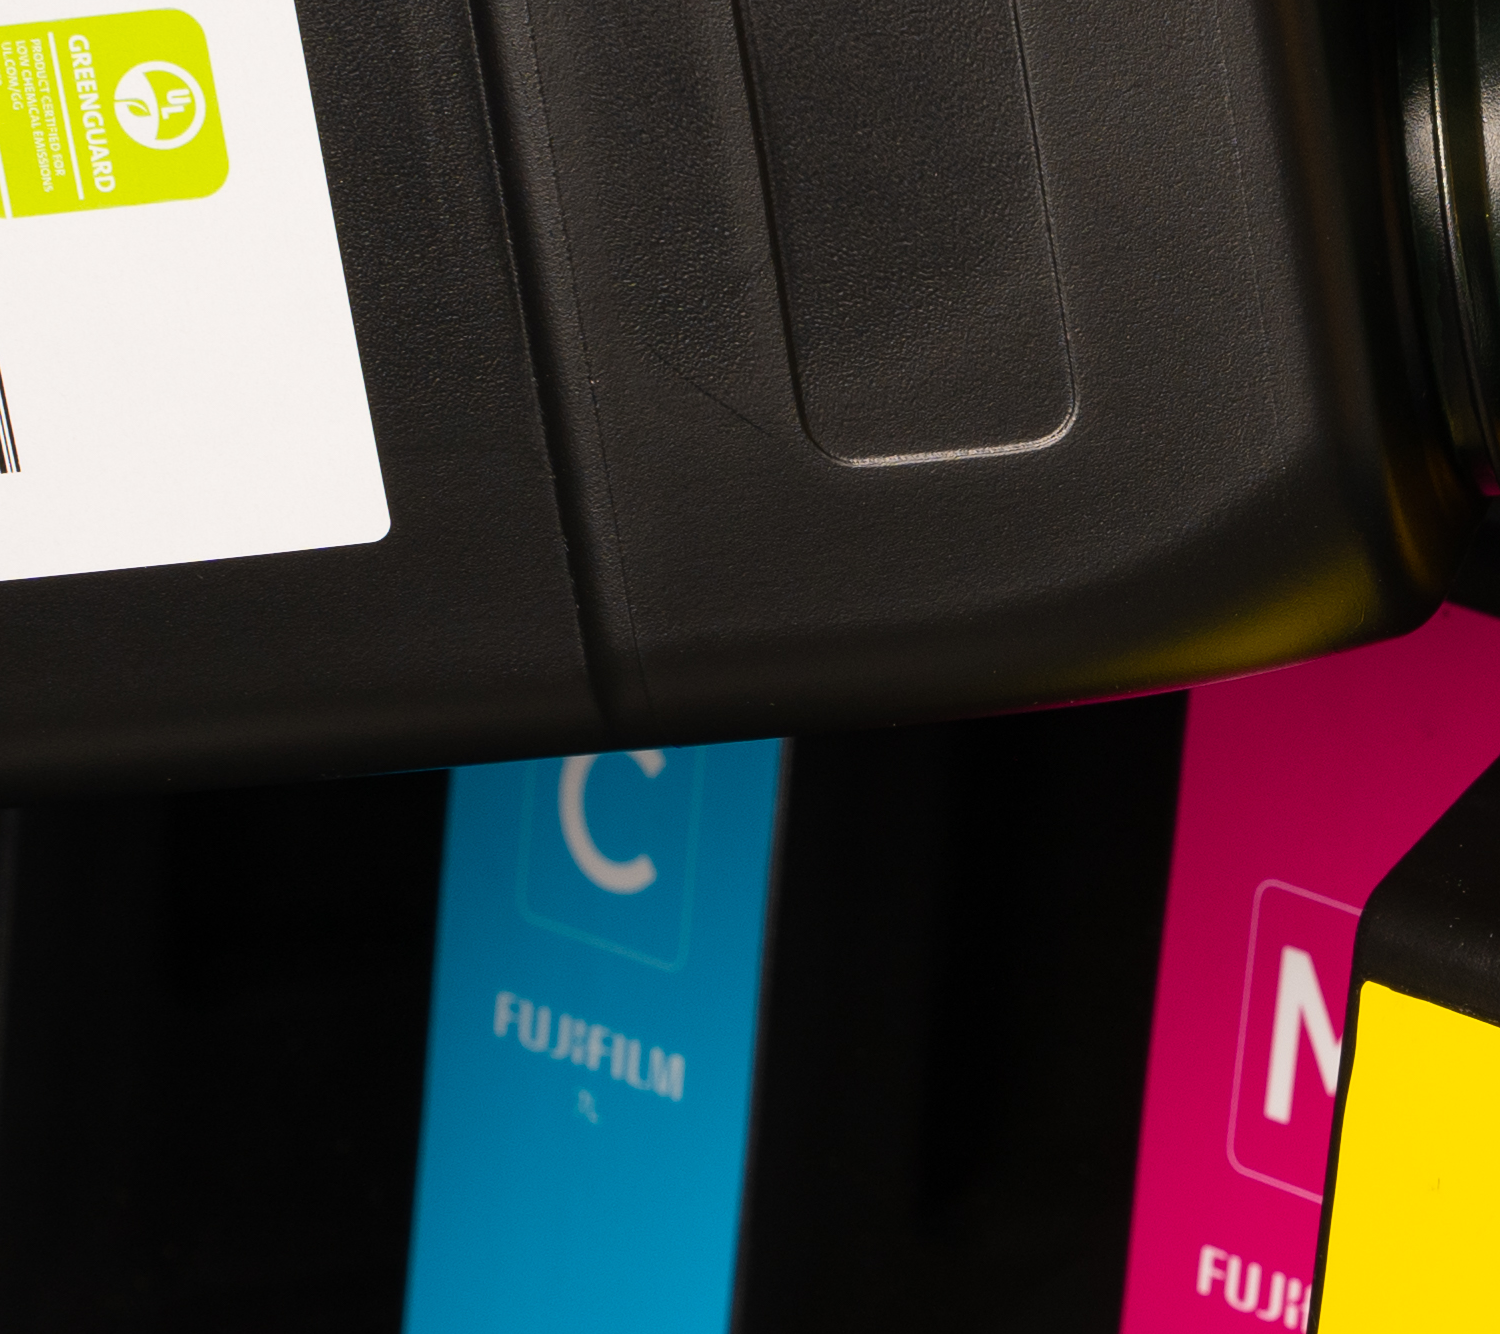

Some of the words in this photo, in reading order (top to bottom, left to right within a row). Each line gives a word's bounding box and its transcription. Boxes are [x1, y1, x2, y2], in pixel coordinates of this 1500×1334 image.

[15, 39, 30, 67] LOW
[21, 69, 41, 129] CHEMICAL
[30, 38, 50, 93] PRODUCT
[41, 95, 62, 152] CERTIFIED
[53, 155, 65, 177] FOR
[68, 34, 116, 193] GREENGUARD
[161, 88, 191, 120] UL
[33, 131, 54, 193] EMISSIONS
[556, 747, 668, 896] C
[492, 989, 687, 1103] FUJIFILM
